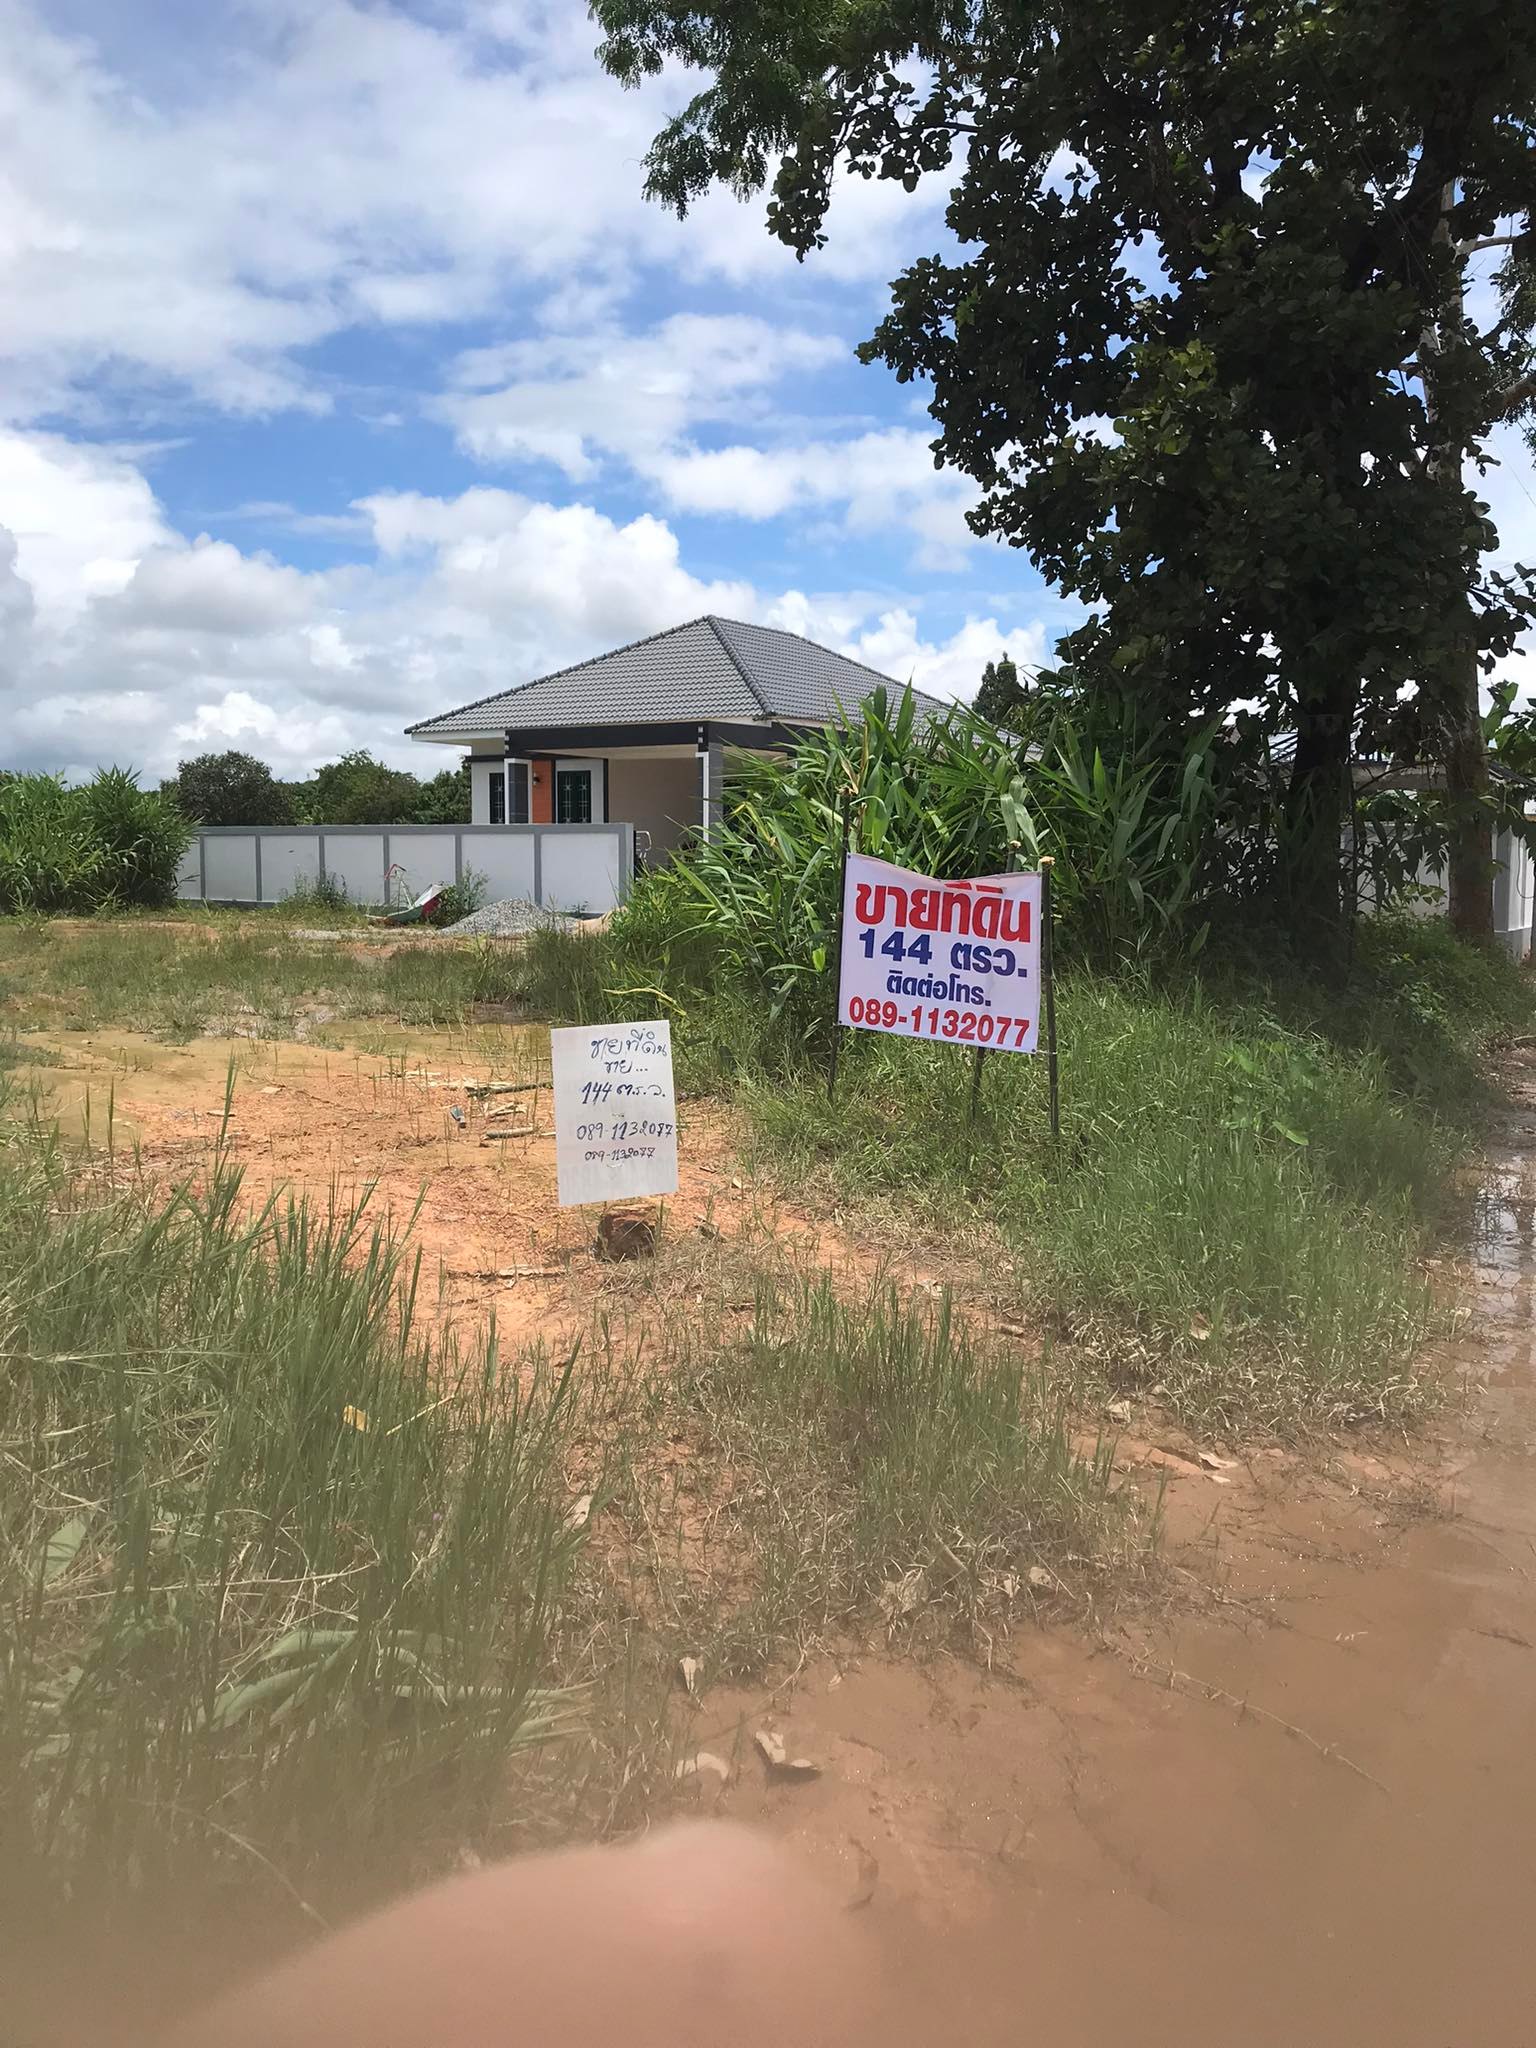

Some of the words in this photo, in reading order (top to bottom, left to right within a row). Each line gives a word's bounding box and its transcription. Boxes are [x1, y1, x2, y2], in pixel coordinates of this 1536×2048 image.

[855, 881, 1031, 943] ขายทีดิน
[859, 928, 933, 965] 144
[950, 942, 1028, 978] ตรว.
[886, 969, 992, 1007] ติดต่อโทร.
[849, 996, 1030, 1047] 089-1132077
[582, 1081, 612, 1104] 144
